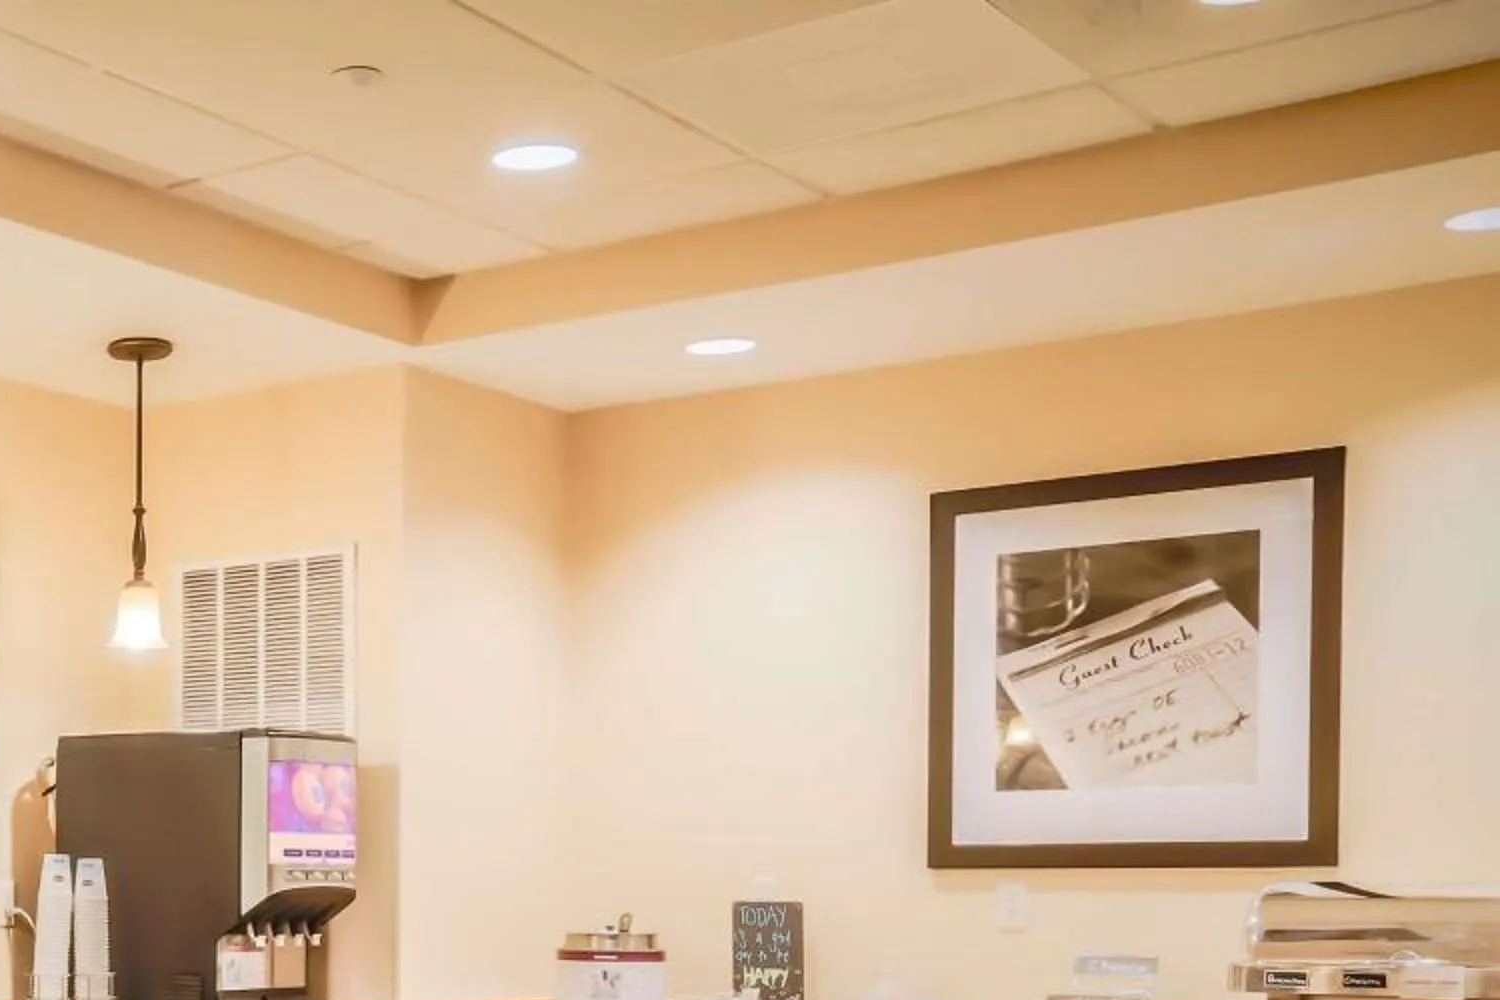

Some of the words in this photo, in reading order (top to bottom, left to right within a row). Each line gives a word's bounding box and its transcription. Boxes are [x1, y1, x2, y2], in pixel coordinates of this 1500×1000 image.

[1059, 656, 1119, 690] Guest
[1129, 626, 1193, 661] Check
[740, 904, 787, 928] TODAY
